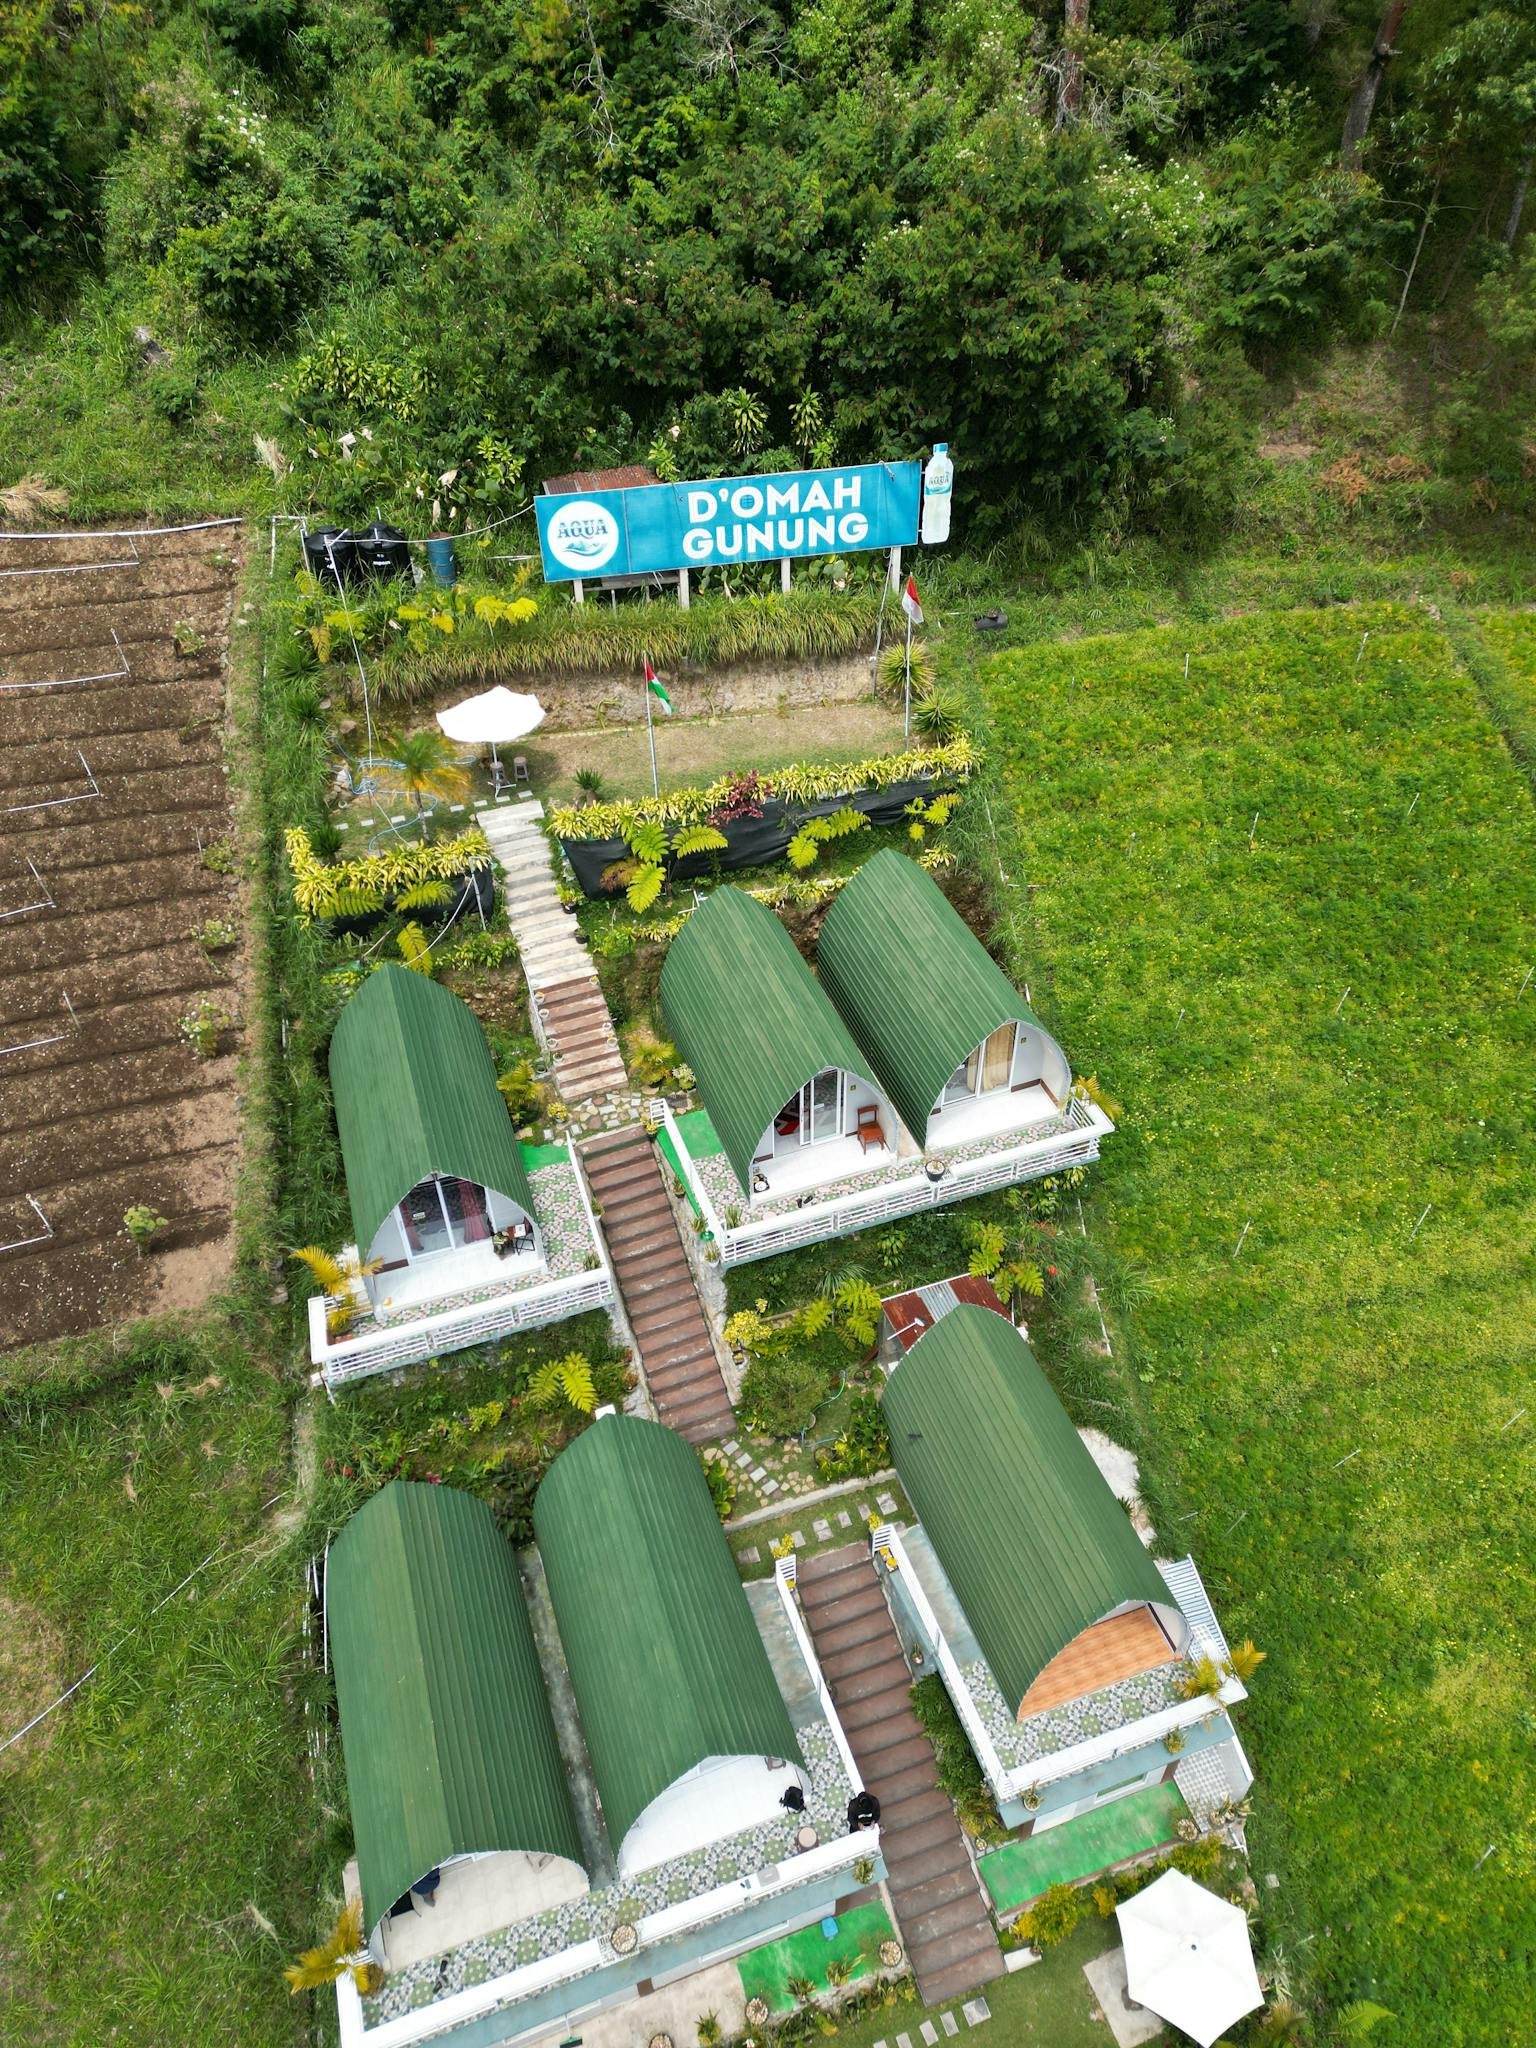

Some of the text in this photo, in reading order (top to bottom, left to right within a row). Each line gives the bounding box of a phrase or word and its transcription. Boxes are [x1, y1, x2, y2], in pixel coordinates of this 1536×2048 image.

[687, 475, 862, 524] D'OMAH
[557, 519, 609, 540] AQUA
[682, 512, 869, 560] GUNUNG
